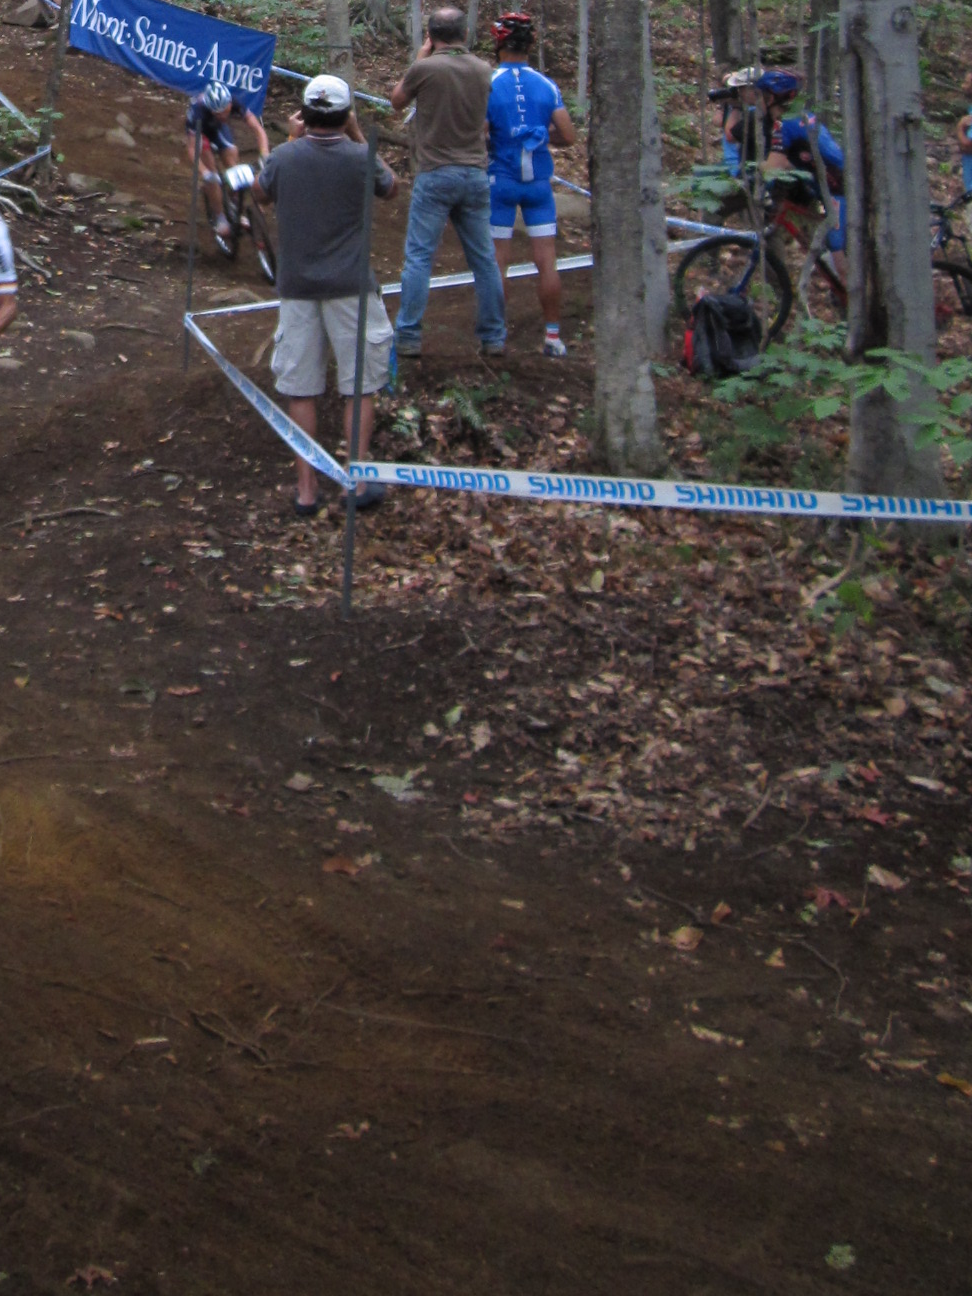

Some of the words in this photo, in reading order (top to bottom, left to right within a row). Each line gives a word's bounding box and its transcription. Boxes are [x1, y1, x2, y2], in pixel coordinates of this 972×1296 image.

[396, 467, 511, 492] SHIMANO
[528, 475, 656, 502] SHIMANO
[675, 484, 818, 510] SHIMANO
